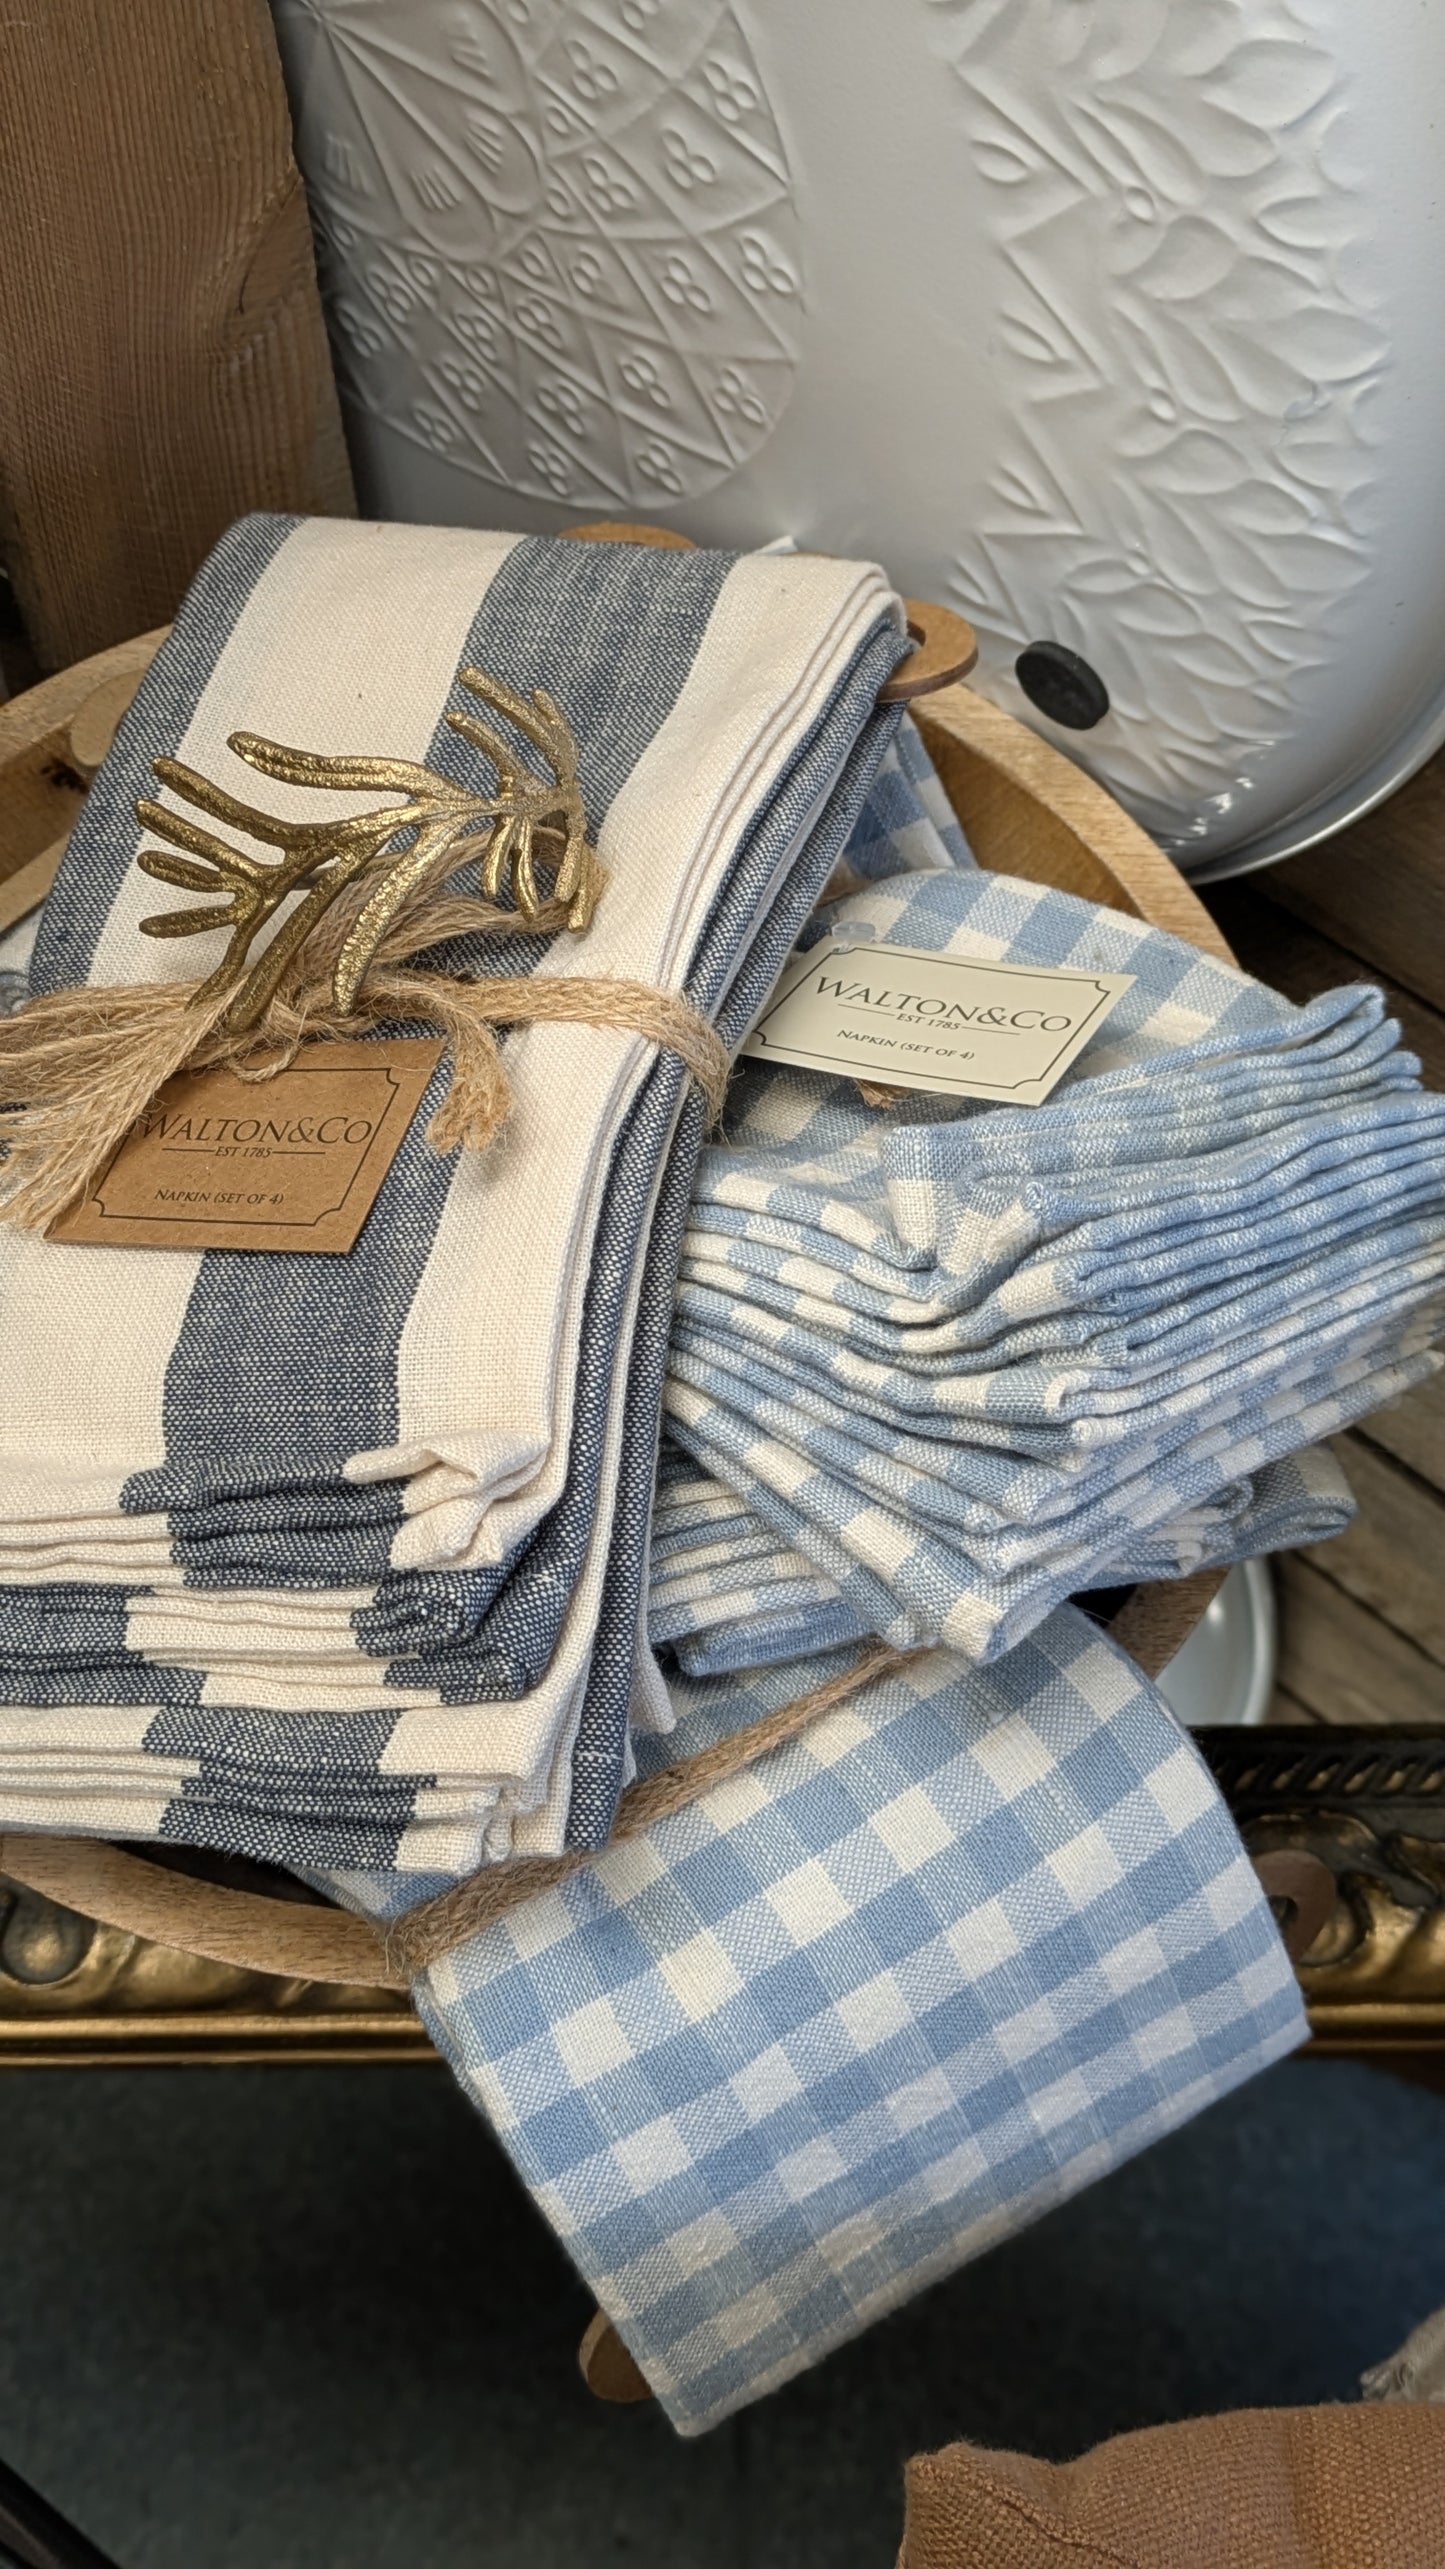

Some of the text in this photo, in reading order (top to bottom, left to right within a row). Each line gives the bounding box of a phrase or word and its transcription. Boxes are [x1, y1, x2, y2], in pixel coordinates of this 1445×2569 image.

[815, 976, 1072, 1032] WALTON&CO
[896, 1013, 961, 1031] EST 1785
[837, 1029, 975, 1061] NAPKIN (SET OF 4)
[142, 1112, 373, 1144] WALTON&CO
[214, 1146, 273, 1158] EST 1785
[154, 1188, 285, 1205] NAPKIN (SET OF 4)
